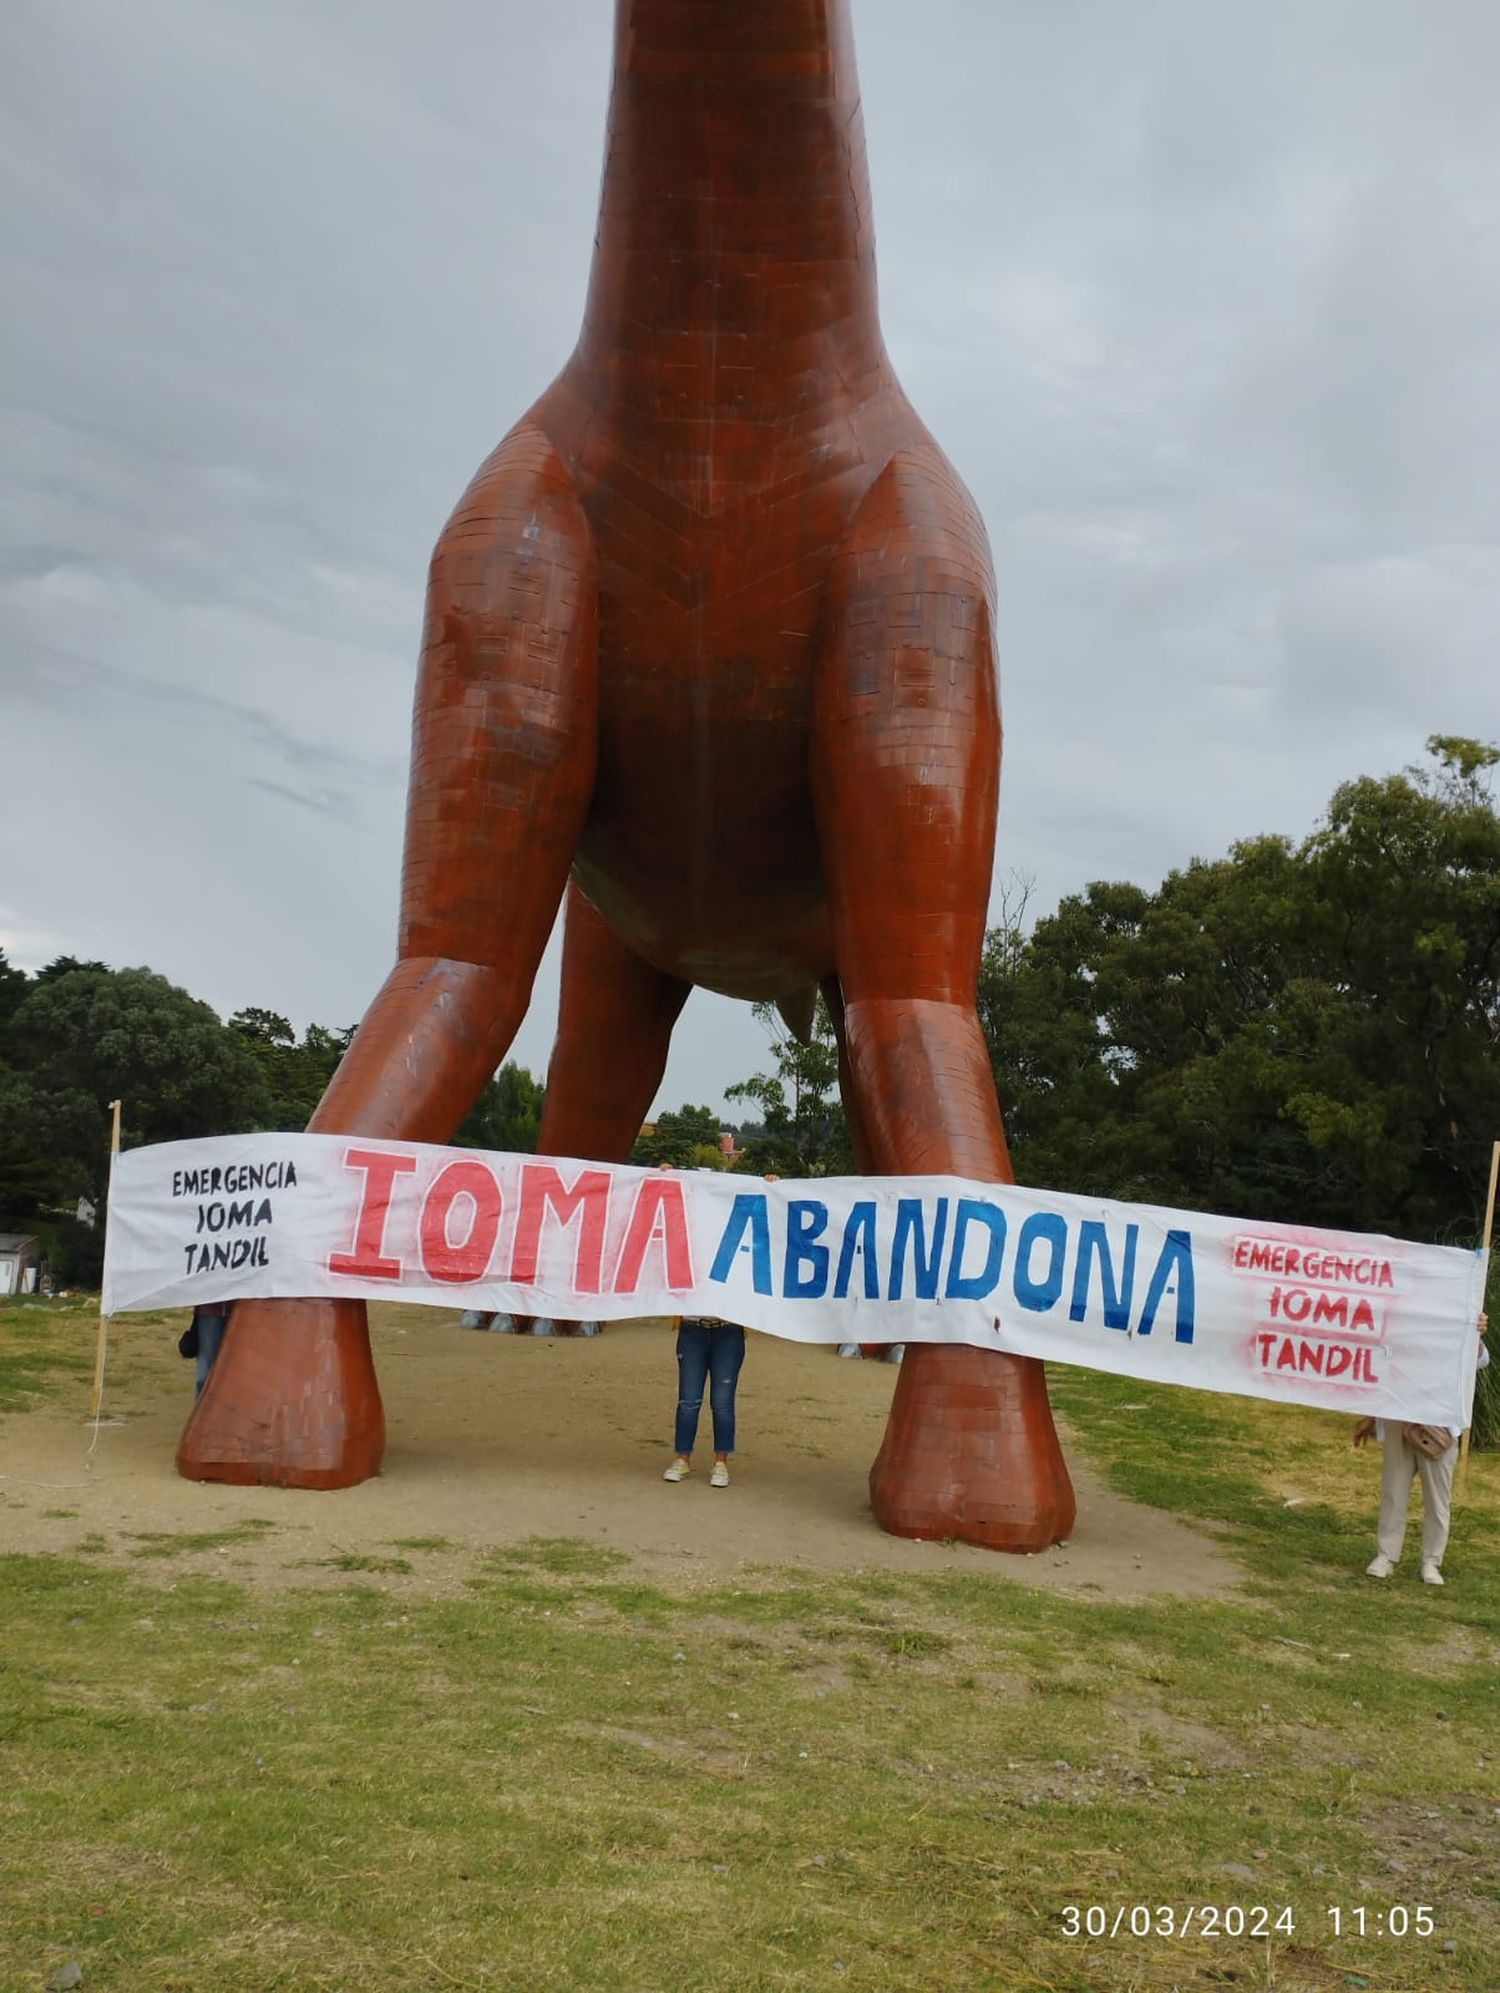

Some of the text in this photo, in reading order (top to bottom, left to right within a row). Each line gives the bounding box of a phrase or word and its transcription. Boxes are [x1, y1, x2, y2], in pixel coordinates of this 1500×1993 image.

[172, 1161, 297, 1197] EMERGENCIA
[196, 1198, 273, 1233] IOMA
[184, 1236, 270, 1274] TANDIL
[328, 1148, 1195, 1344] IOMA ABANDONA
[1233, 1236, 1395, 1289] EMERGENCIA
[1268, 1285, 1376, 1332] IOMA
[1257, 1333, 1379, 1383] TANDIL
